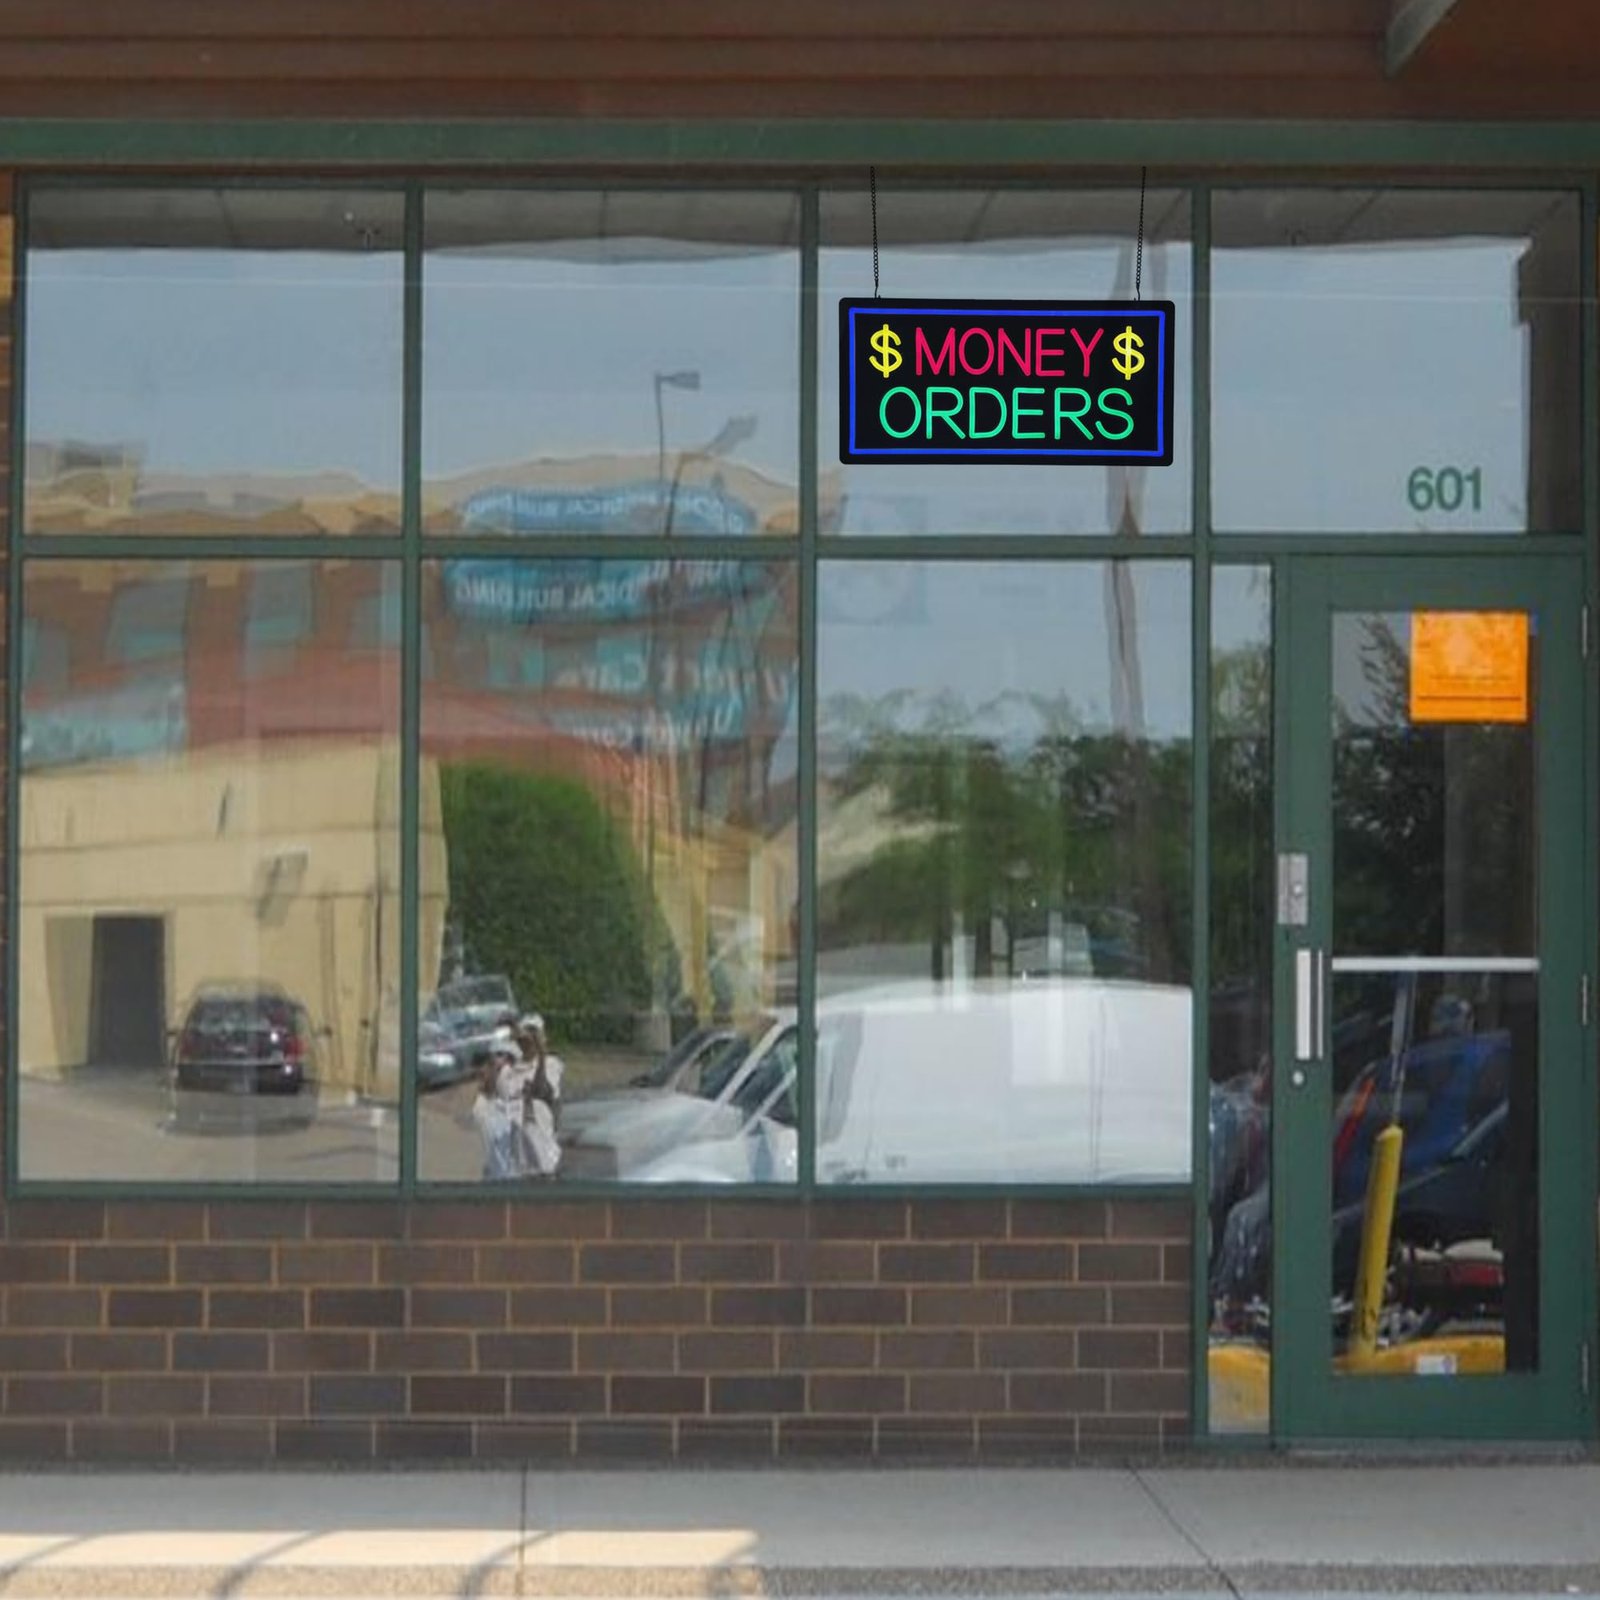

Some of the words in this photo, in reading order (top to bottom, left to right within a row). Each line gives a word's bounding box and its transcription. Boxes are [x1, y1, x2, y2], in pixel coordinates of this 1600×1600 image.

[868, 323, 903, 379] $
[915, 326, 1105, 378] MONEY
[1111, 325, 1146, 381] $
[879, 385, 1135, 441] ORDERS
[1407, 465, 1482, 512] 601
